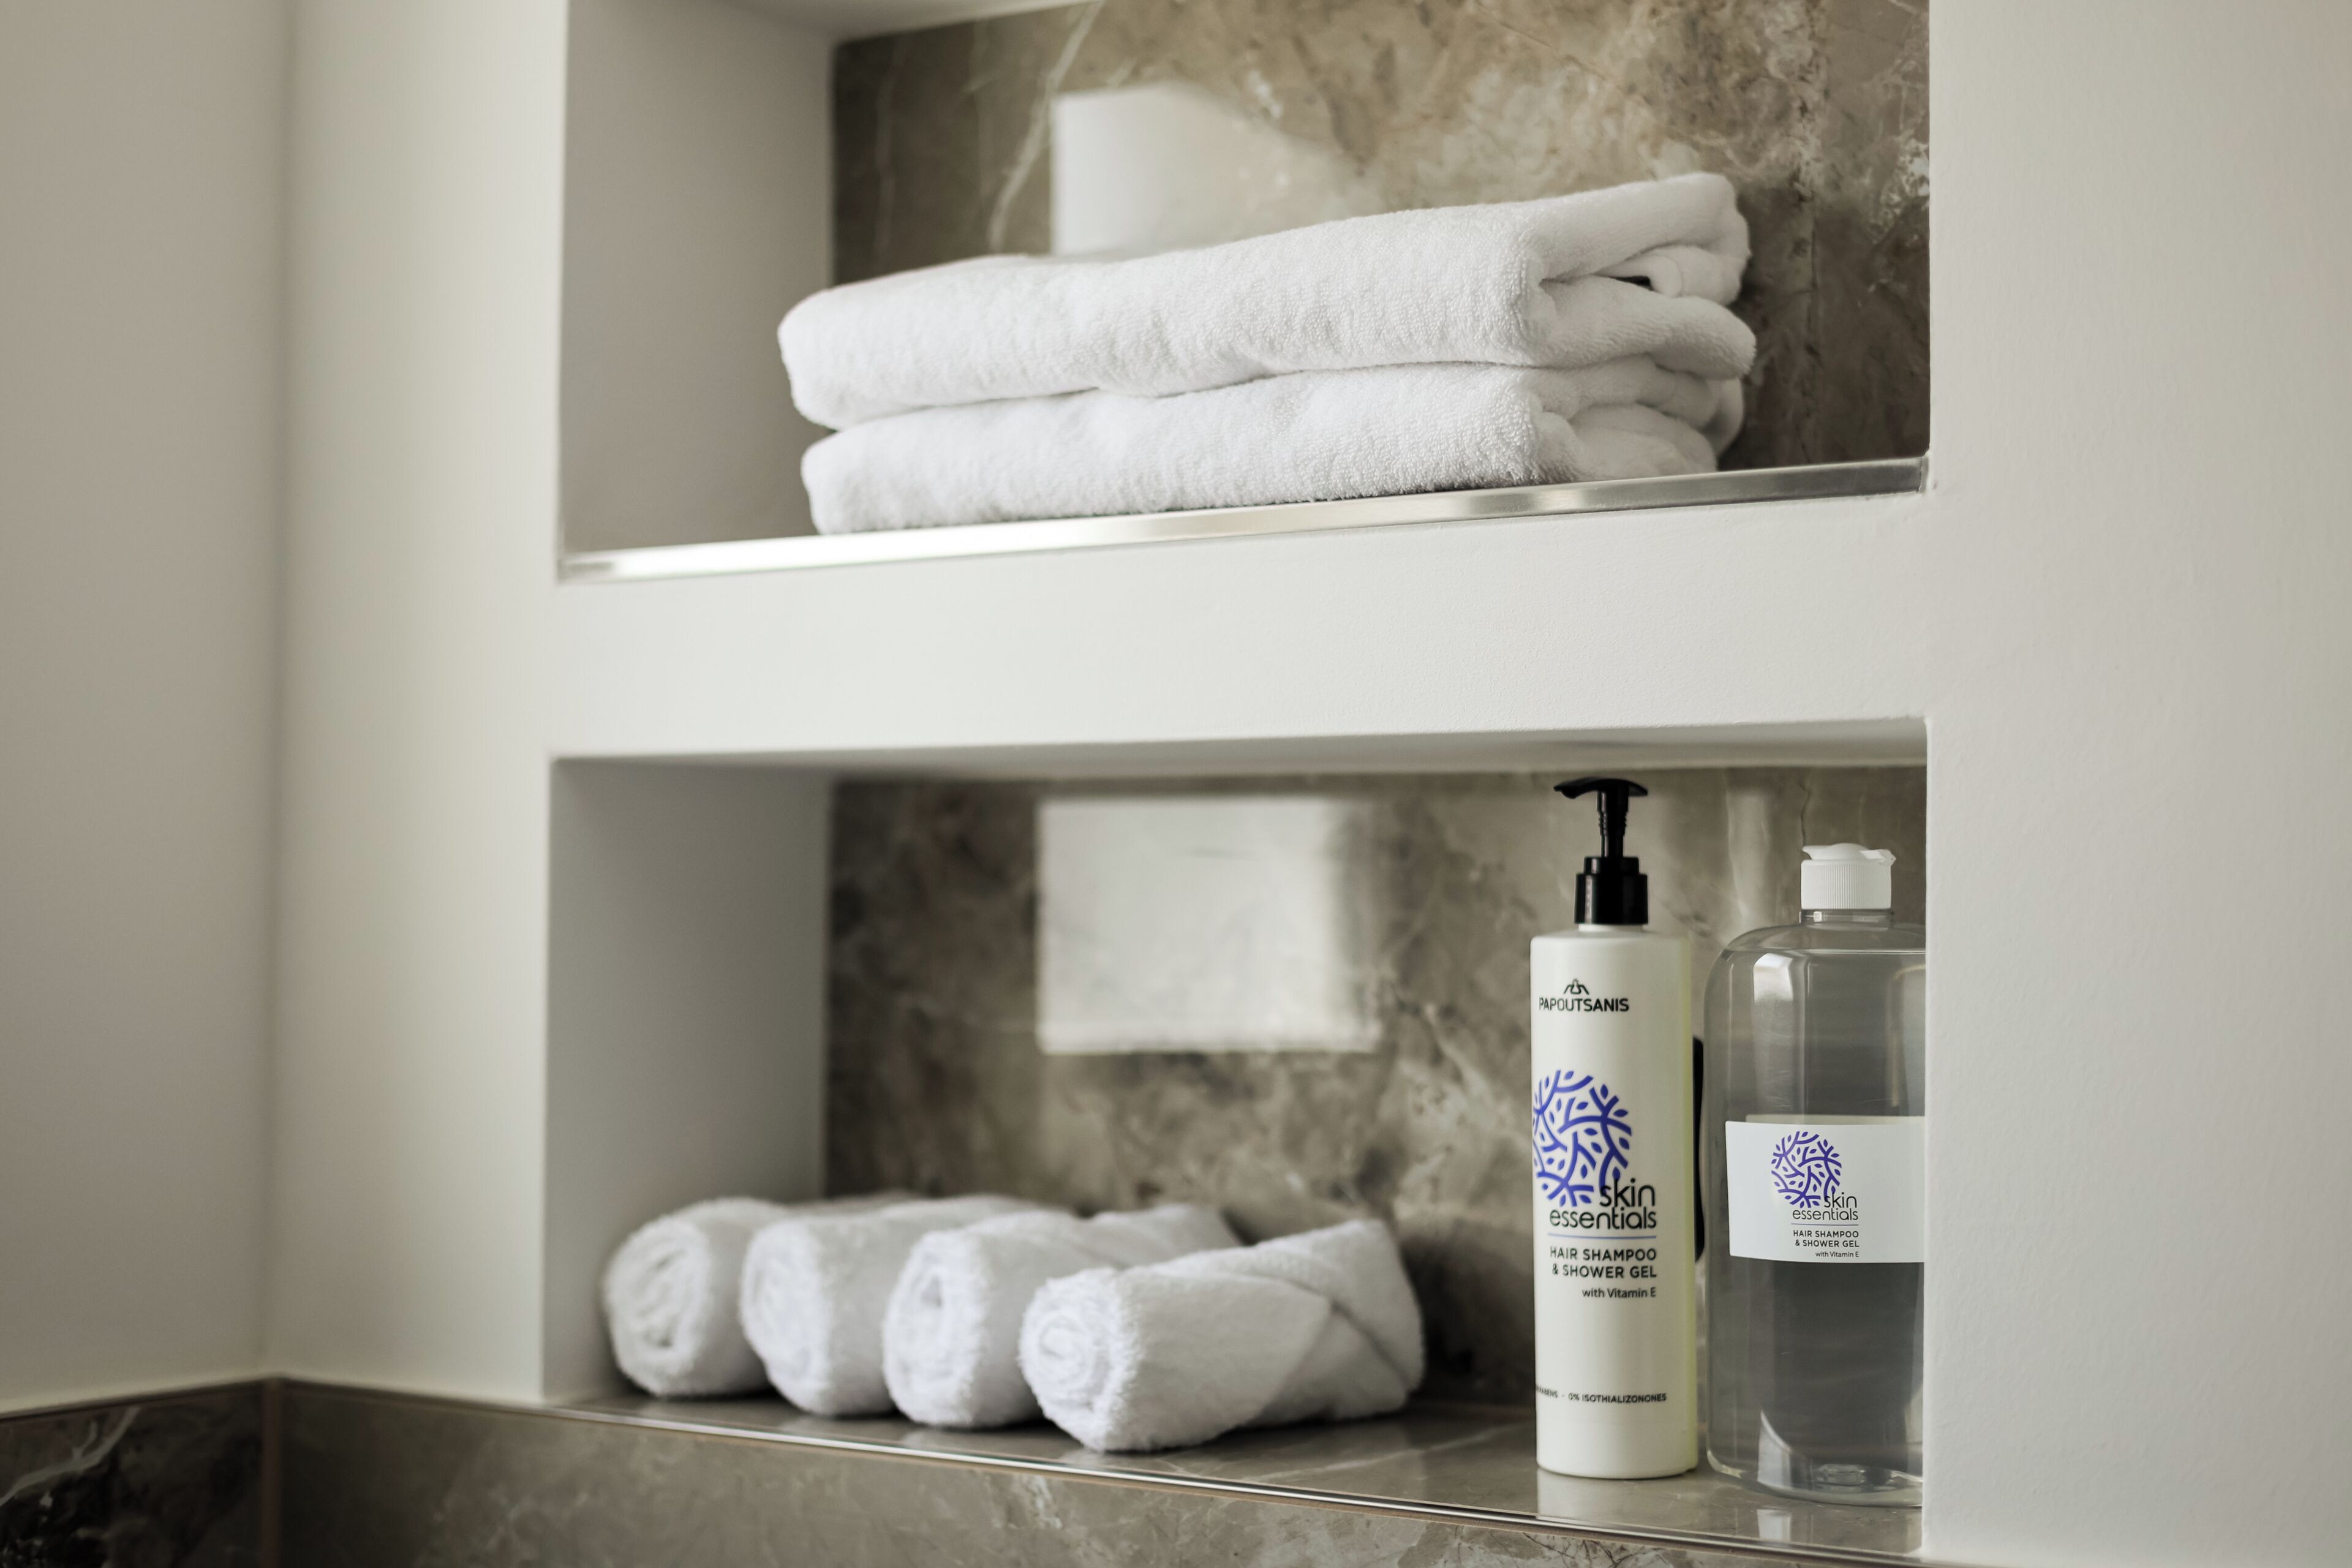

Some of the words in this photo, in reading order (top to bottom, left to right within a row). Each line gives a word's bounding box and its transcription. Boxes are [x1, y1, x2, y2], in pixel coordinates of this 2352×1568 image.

[1539, 997, 1629, 1012] PAPOUTSANIS
[1599, 1177, 1656, 1207] skin
[1824, 1192, 1857, 1208] skin
[1549, 1207, 1657, 1229] essentials
[1792, 1208, 1858, 1221] essentials
[1550, 1246, 1577, 1259] HAIR
[1583, 1248, 1657, 1261] SHAMPOO
[1552, 1264, 1558, 1275] &
[1562, 1264, 1624, 1278] SHOWER
[1629, 1266, 1657, 1278] GEL
[1582, 1287, 1605, 1297] with
[1607, 1288, 1647, 1298] Vitamin
[1650, 1287, 1656, 1297] E
[1568, 1392, 1580, 1401] 0%
[1582, 1393, 1667, 1403] ISOTHIALIZONONES
